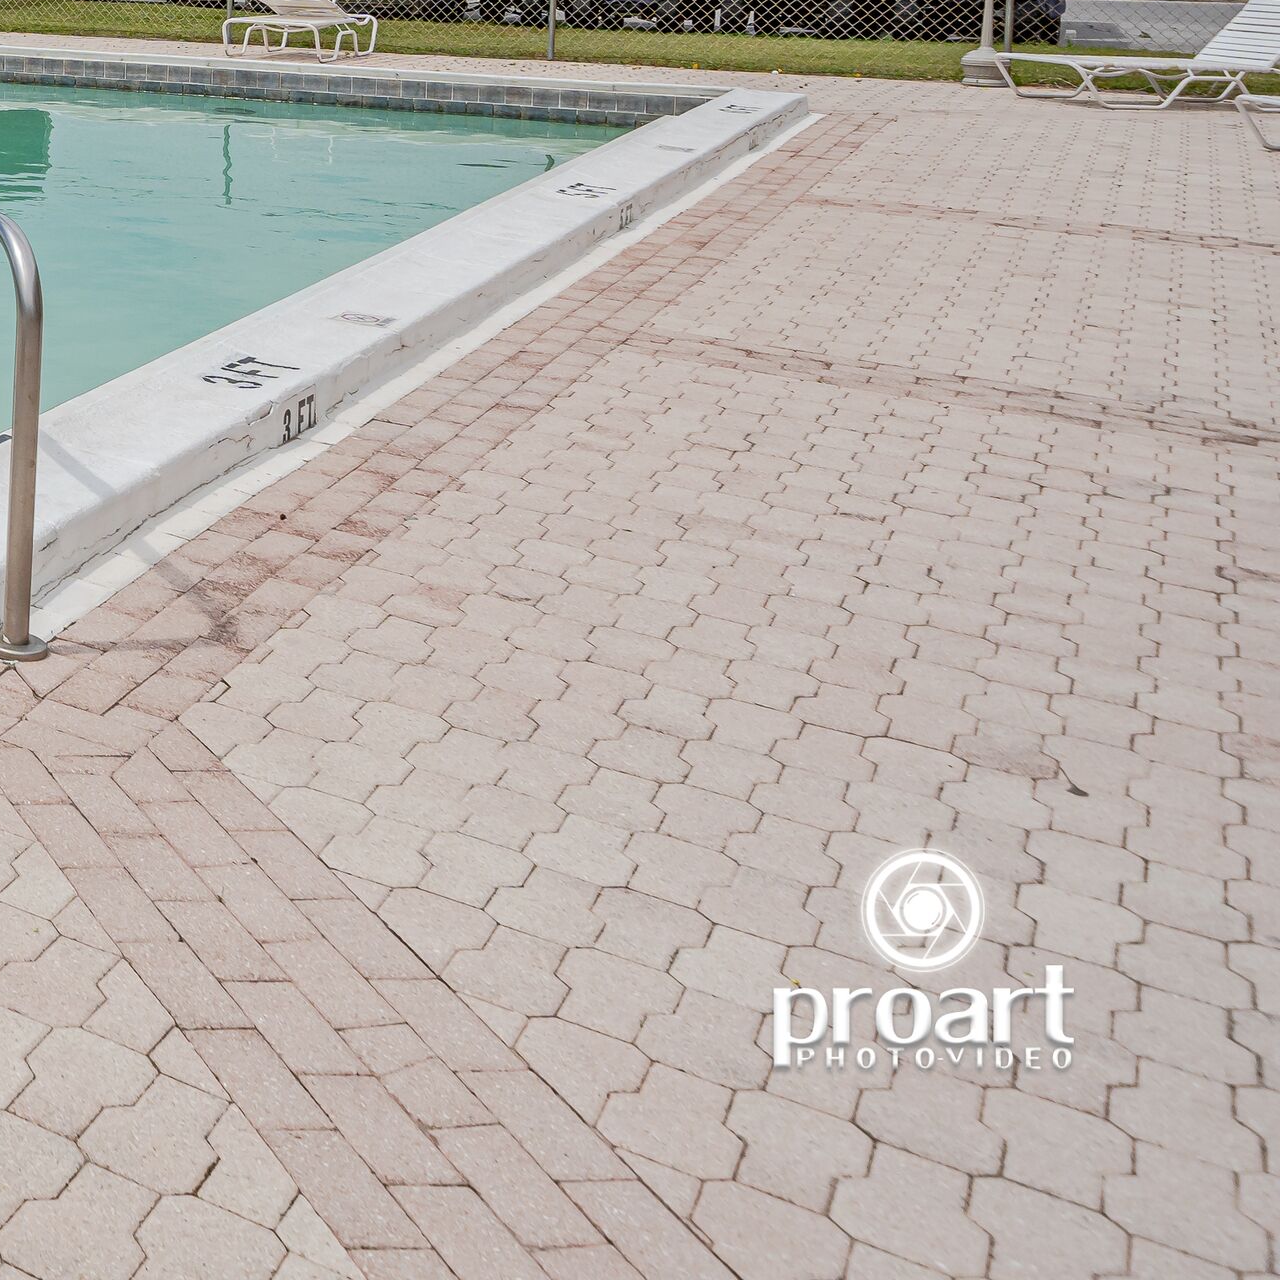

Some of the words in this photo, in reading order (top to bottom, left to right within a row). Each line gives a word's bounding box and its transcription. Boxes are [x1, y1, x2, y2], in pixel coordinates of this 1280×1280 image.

[220, 356, 301, 379] FT
[201, 375, 263, 389] 3
[282, 408, 292, 444] 3
